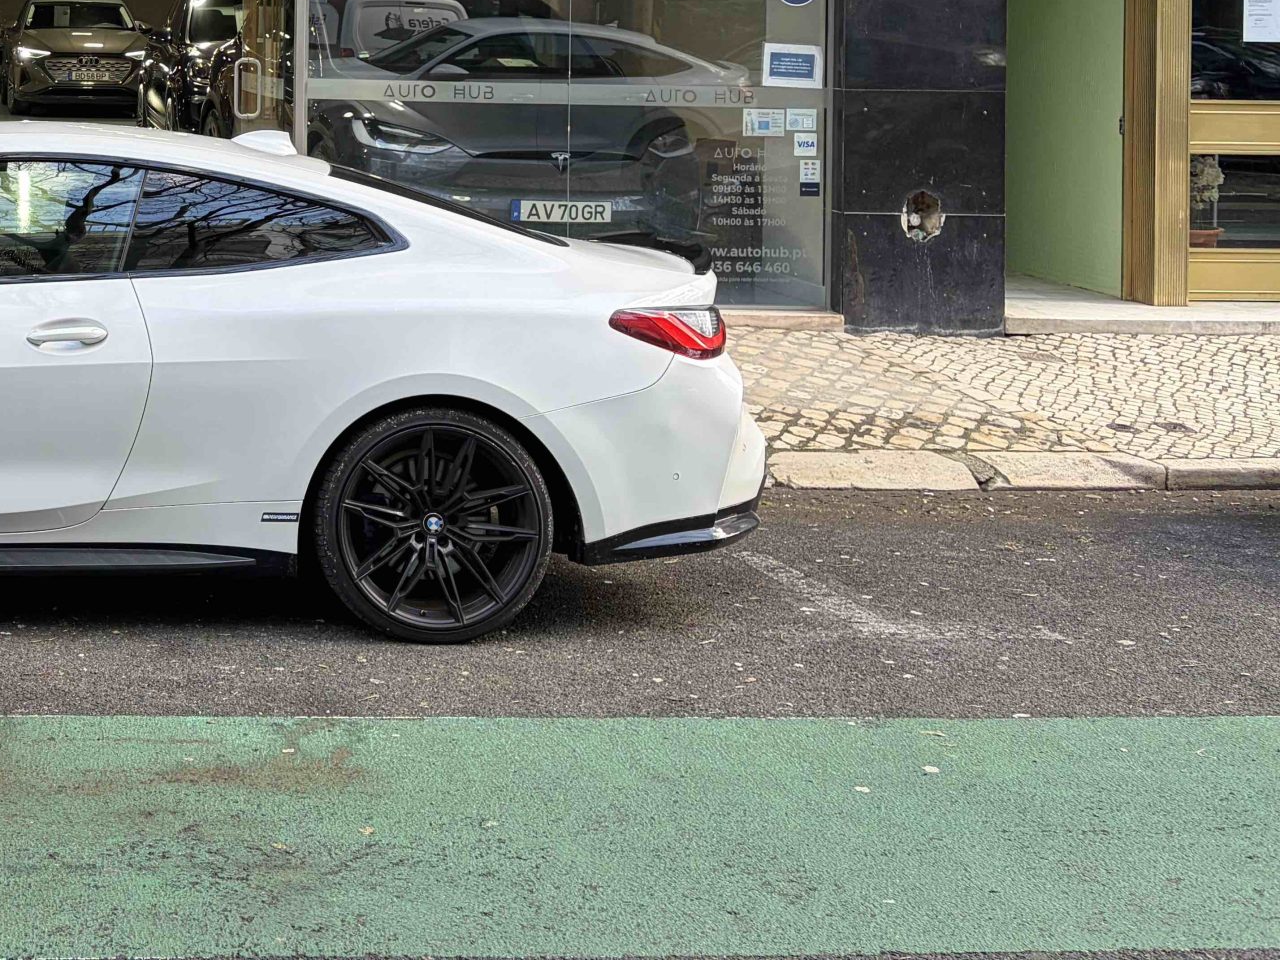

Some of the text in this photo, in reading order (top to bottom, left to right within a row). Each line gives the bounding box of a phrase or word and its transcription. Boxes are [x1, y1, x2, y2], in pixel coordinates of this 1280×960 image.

[383, 83, 494, 100] AUTO HUB
[645, 88, 754, 104] AUTO HUB
[714, 147, 753, 159] AUTO
[733, 162, 767, 171] Horário
[711, 173, 752, 184] Segunda
[712, 185, 742, 193] 09H30
[713, 195, 742, 204] 14H30
[526, 203, 606, 220] AV70GR
[732, 206, 767, 215] Sábado
[712, 217, 742, 226] 10H00
[756, 217, 786, 226] 17H00
[735, 261, 761, 273] 646
[764, 262, 791, 273] 460
